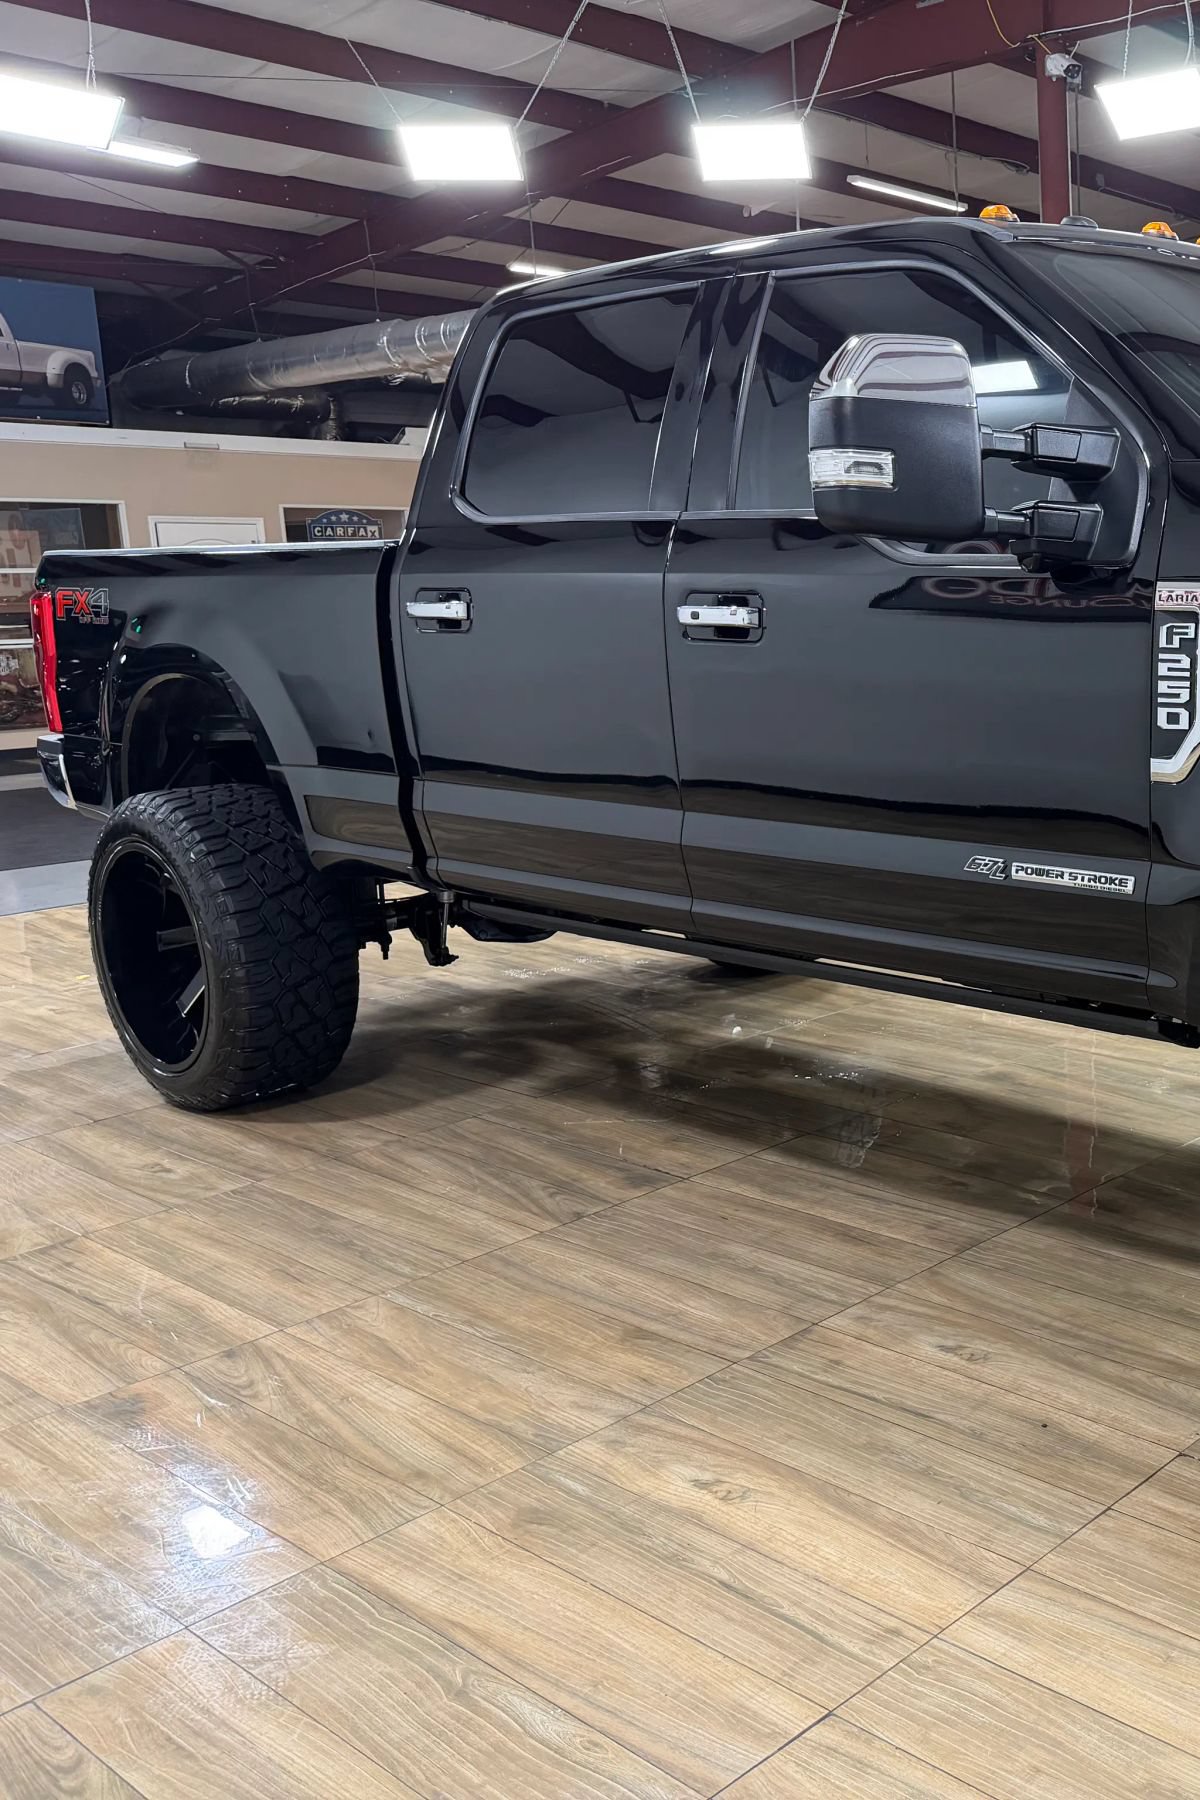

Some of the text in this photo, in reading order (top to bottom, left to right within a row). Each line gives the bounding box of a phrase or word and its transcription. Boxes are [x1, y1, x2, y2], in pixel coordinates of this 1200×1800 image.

[314, 526, 378, 538] CARFAX
[55, 587, 109, 621] FX4
[963, 855, 1130, 888] 6.7L POWER STROKE
